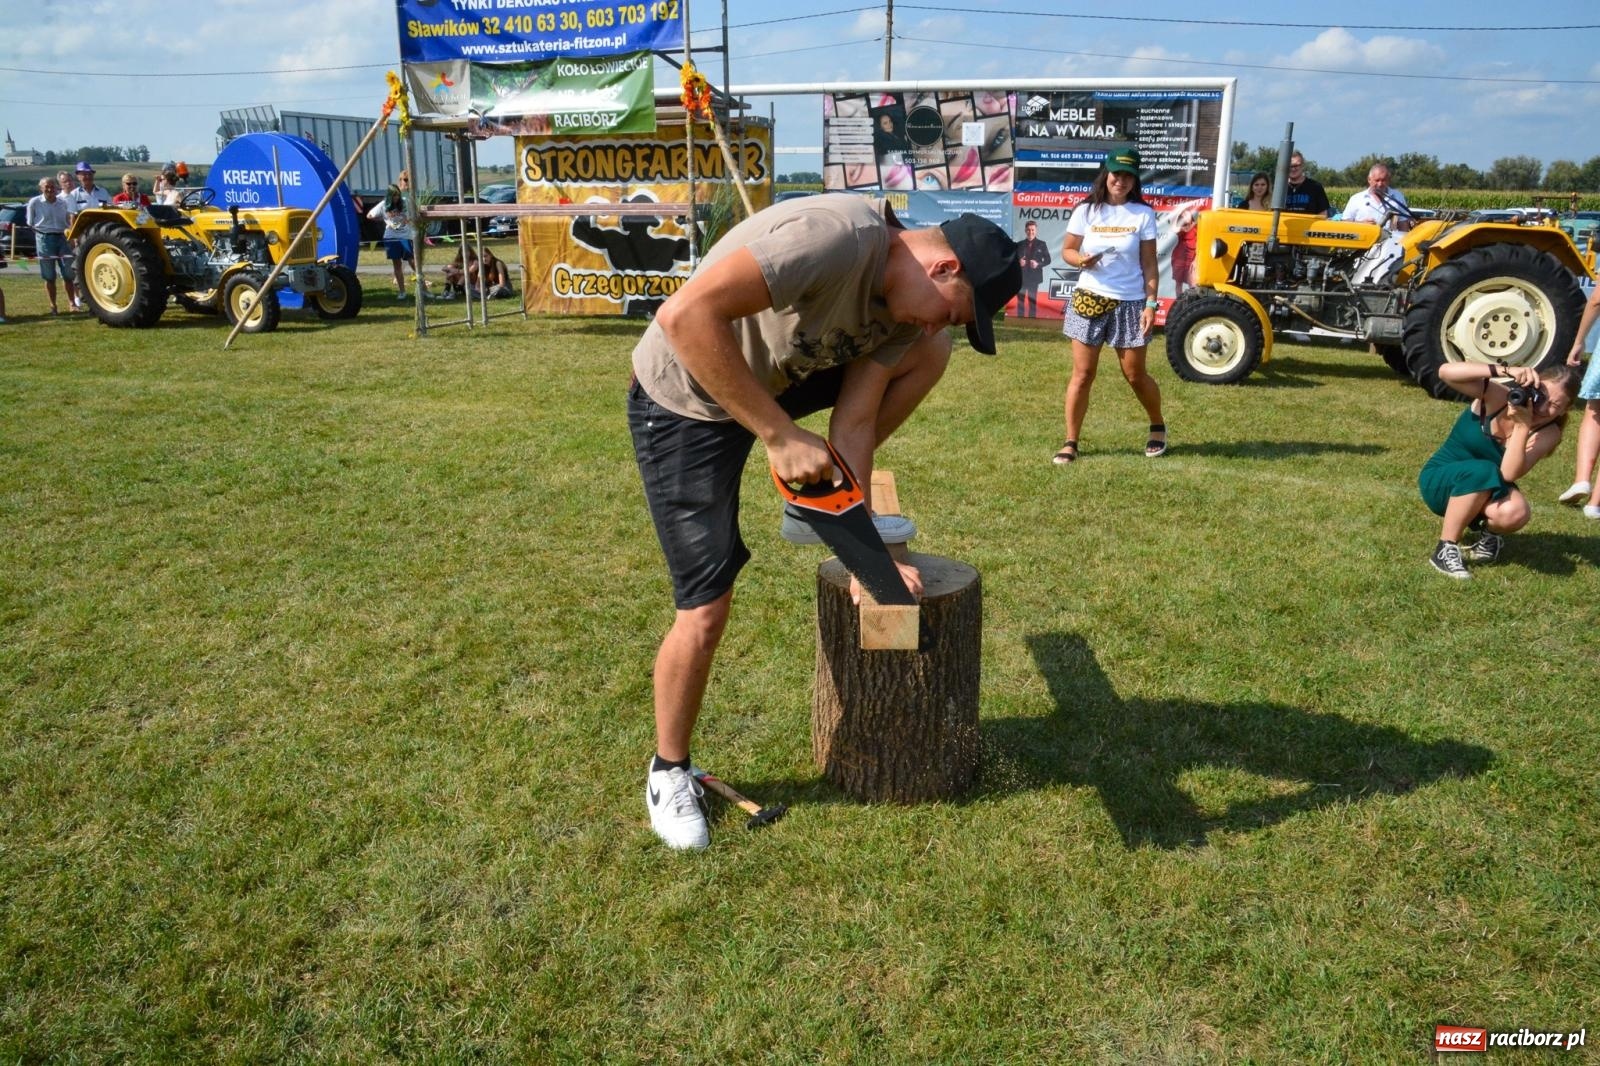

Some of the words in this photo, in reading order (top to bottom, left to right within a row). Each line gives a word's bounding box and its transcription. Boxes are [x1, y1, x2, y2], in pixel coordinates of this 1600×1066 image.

[408, 20, 479, 38] Sławików
[482, 17, 500, 34] 32
[504, 16, 532, 33] 410
[537, 14, 555, 31] 63
[559, 12, 582, 32] 30,
[587, 9, 614, 28] 603
[619, 6, 646, 25] 703
[652, 1, 679, 20] 192
[462, 33, 626, 55] www.sztukateria-fitzon.pl
[557, 63, 588, 77] KOŁO
[590, 57, 648, 76] ŁOWIECKIE
[554, 111, 618, 128] RACIBÓRZ
[1049, 107, 1096, 121] MEBLE
[1029, 124, 1049, 137] NA
[1055, 124, 1116, 138] WYMIAR
[225, 188, 260, 203] studio
[1017, 192, 1065, 205] Garnitury
[1019, 207, 1059, 220] MODA
